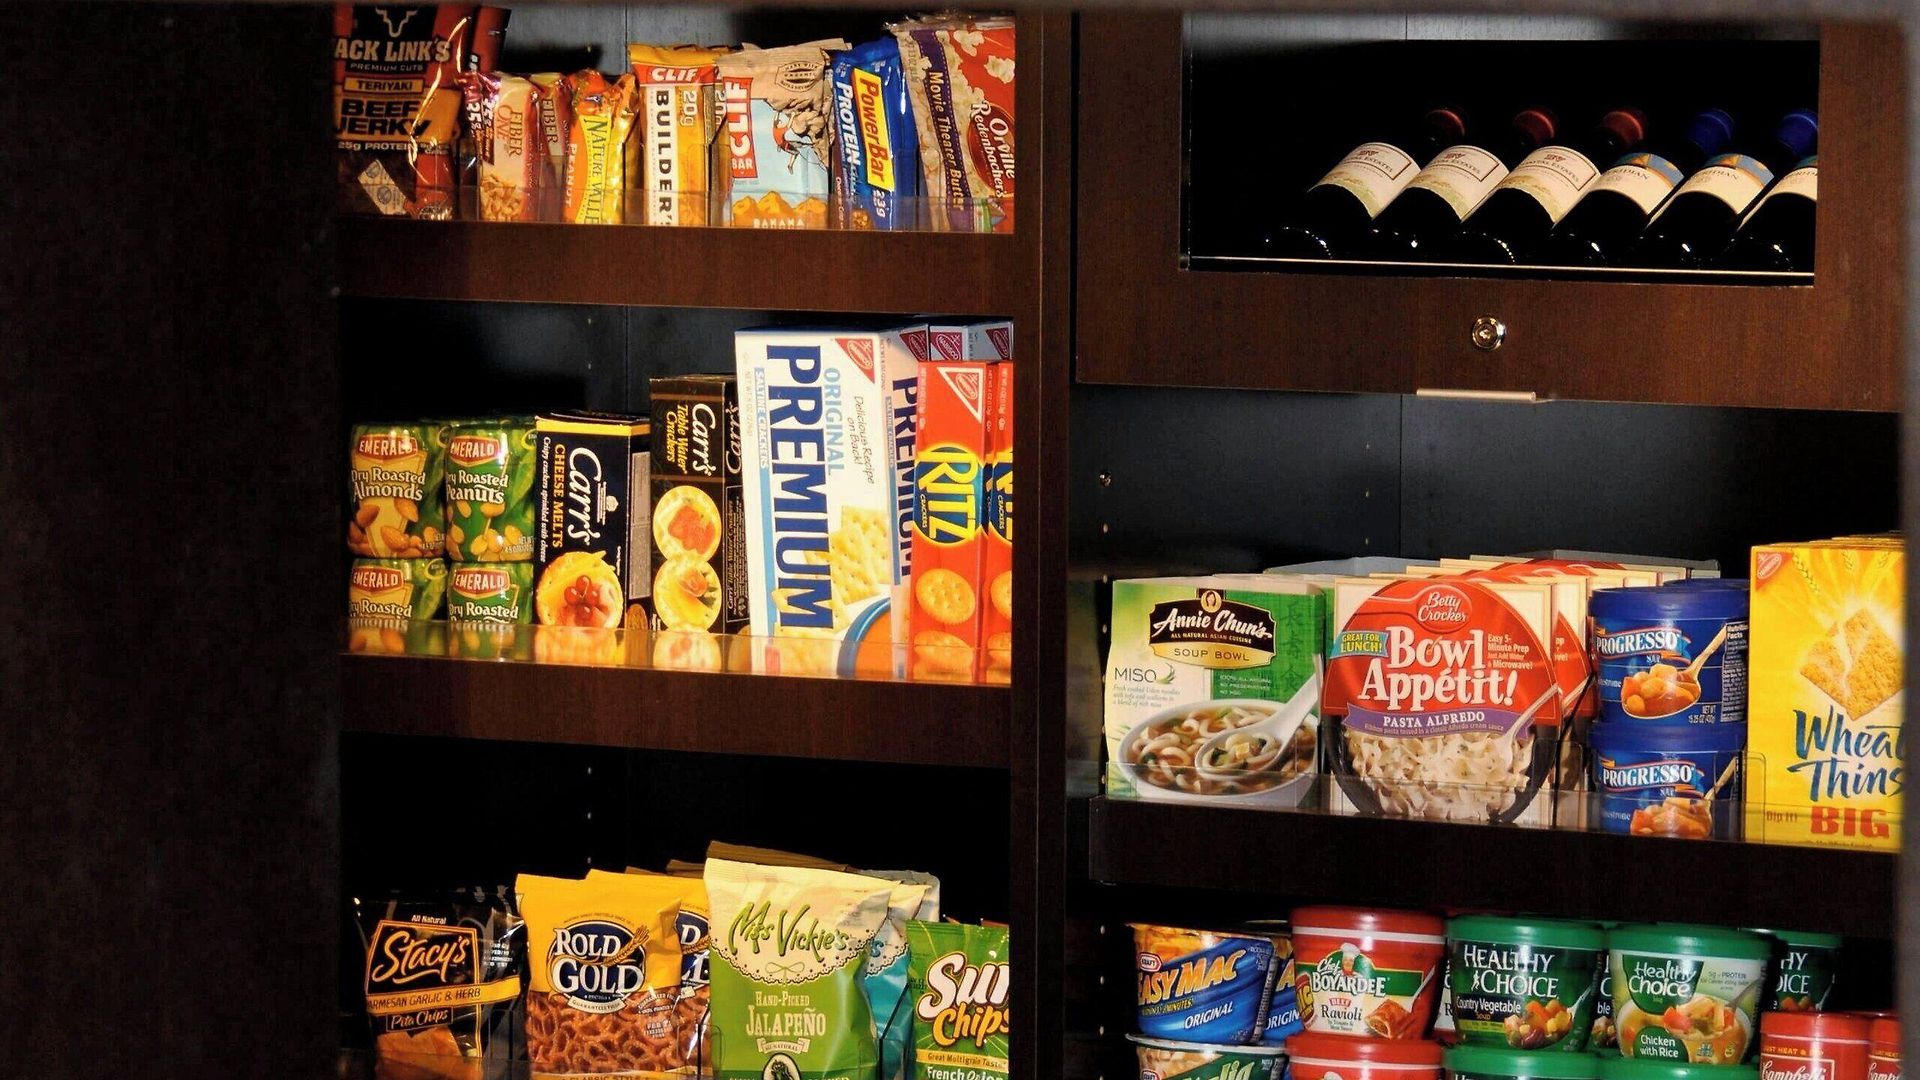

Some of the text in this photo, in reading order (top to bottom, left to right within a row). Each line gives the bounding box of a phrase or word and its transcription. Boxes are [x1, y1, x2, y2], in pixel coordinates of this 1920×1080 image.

[334, 38, 451, 62] ACK LINK'S
[350, 62, 424, 72] PREMIUM CUTS
[650, 68, 698, 82] CLIF
[357, 80, 413, 90] TERIYAKI
[342, 99, 422, 118] BEEF
[542, 99, 558, 143] FIBER
[680, 90, 698, 127] 20g
[725, 81, 750, 157] CLIF
[335, 118, 433, 137] JERKY
[497, 105, 512, 141] ONE
[509, 111, 523, 157] FIBER
[836, 81, 860, 165] PROTEIN
[860, 77, 890, 182] PowerBar
[338, 141, 361, 151] 25g
[365, 142, 417, 151] PROTEIN
[929, 71, 966, 211] Movie Theater Butter
[970, 100, 1008, 198] Redenbacher's
[989, 117, 1015, 178] Orville
[565, 143, 577, 208] PEANUT
[584, 116, 608, 224] NATURE VALLE
[732, 158, 754, 170] BAR
[872, 189, 886, 218] 23g
[753, 218, 806, 228] BANANA
[825, 367, 845, 475] ORIGINAL
[359, 438, 414, 455] EMERALD
[666, 411, 678, 462] Crackers
[677, 403, 688, 472] Table Water
[692, 403, 717, 477] Carr's
[758, 416, 769, 469] CRACKERS
[847, 417, 862, 465] on Back!
[854, 395, 876, 485] Delicious Recipe
[372, 468, 426, 485] Roasted
[458, 470, 509, 487] Roasted
[766, 344, 834, 630] PREMIUM
[352, 483, 423, 500] Almonds
[539, 436, 551, 563] Crispy crackers sprinkled with cheese
[552, 443, 567, 548] CHEESE MELTS
[567, 447, 602, 546] Carr's
[918, 451, 980, 541] RITZ
[920, 494, 928, 529] CRACKERS
[998, 495, 1006, 529] CRACKERS
[353, 571, 399, 587] EMERALD
[455, 574, 505, 589] EMERALD
[362, 600, 413, 618] Roasted
[466, 602, 519, 618] Roasted
[1427, 591, 1462, 610] Betty
[1151, 607, 1273, 638] Annie Chun's
[1417, 606, 1468, 623] Crocker
[1229, 635, 1252, 644] CUISINE
[1341, 641, 1383, 653] LUNCH!
[1343, 634, 1381, 643] GREAT FOR
[1386, 625, 1486, 670] Bowl
[1487, 634, 1503, 644] Easy
[1487, 643, 1530, 655] Minute Prep
[1597, 631, 1678, 655] PROGRESSO
[1174, 647, 1250, 661] SOUP BOWL
[1114, 667, 1157, 683] MISO
[1357, 657, 1518, 712] Appétit!
[1383, 711, 1486, 728] PASTA ALFREDO
[1793, 704, 1904, 760] Wheat
[1603, 764, 1695, 787] PROGRESSO
[1787, 757, 1905, 802] Thins
[1810, 805, 1890, 839] BIG
[422, 916, 447, 925] Natural
[728, 900, 850, 963] Miss Vickie's
[553, 927, 621, 957] ROLD
[372, 930, 470, 984] Stacy's
[1317, 958, 1341, 976] Chef
[1464, 944, 1555, 974] HEALTHY
[552, 958, 644, 994] GOLD
[1175, 949, 1247, 997] MAC
[1312, 972, 1387, 998] BOYARDEE
[1480, 969, 1559, 999] CHOICE
[1634, 960, 1697, 984] Healthy
[410, 994, 441, 1006] GARLIC
[456, 988, 481, 1000] HERB
[755, 990, 810, 1006] HAND-PICKED
[1628, 975, 1691, 997] Choice
[1184, 1001, 1234, 1030] ORIGINAL
[1320, 1005, 1363, 1021] Ravioli
[1457, 995, 1521, 1014] Country Vegetable
[391, 1009, 448, 1029] Pita Chips
[746, 1004, 826, 1037] JALAPEÑO
[933, 1001, 1009, 1048] Chips
[1640, 1034, 1676, 1047] Chicken
[1640, 1047, 1679, 1058] with Rice
[1778, 1046, 1798, 1055] HEAT
[927, 1052, 945, 1061] Great
[927, 1066, 965, 1080] French
